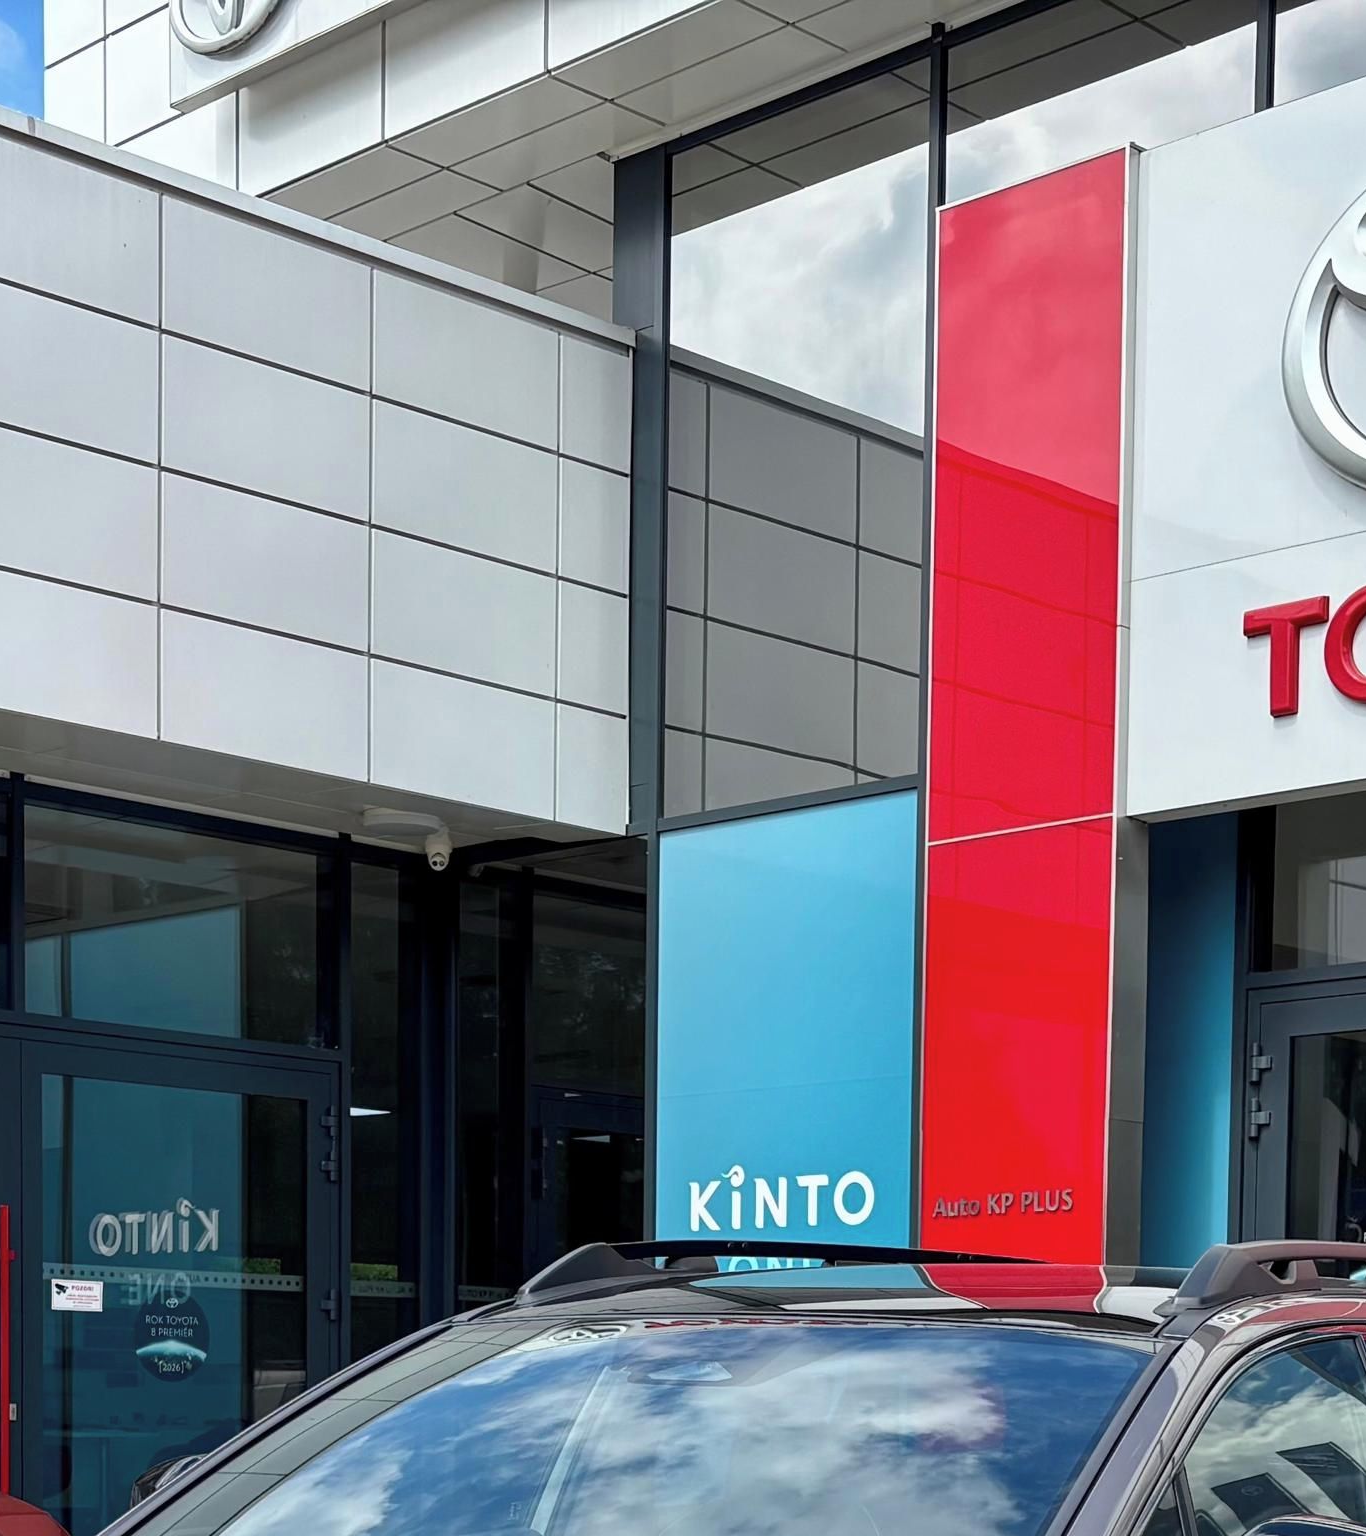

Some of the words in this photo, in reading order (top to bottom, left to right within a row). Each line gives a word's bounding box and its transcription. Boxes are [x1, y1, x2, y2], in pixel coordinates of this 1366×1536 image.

[932, 1196, 981, 1218] Auto
[987, 1193, 1013, 1215] KP
[1021, 1188, 1074, 1213] PLUS
[146, 1315, 163, 1325] ROK
[166, 1316, 199, 1326] TOYOTA
[151, 1328, 156, 1337] 8
[158, 1326, 194, 1337] PREMIÉR
